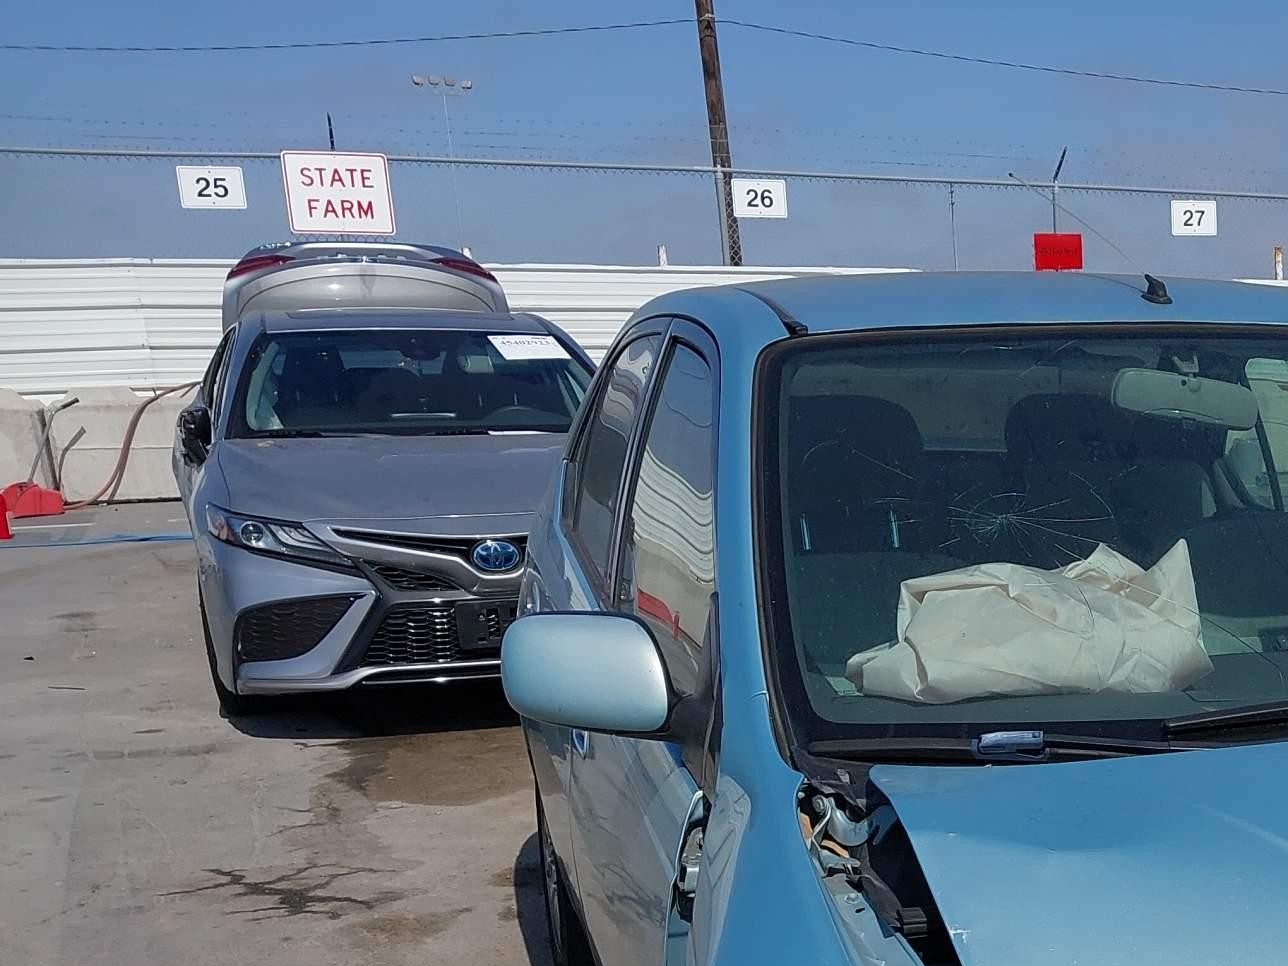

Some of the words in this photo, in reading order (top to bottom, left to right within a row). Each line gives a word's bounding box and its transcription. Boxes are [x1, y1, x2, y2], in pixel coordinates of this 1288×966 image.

[195, 177, 229, 198] 25
[300, 167, 375, 189] STATE
[307, 198, 375, 220] FARM
[746, 188, 774, 209] 26
[1183, 209, 1205, 227] 27
